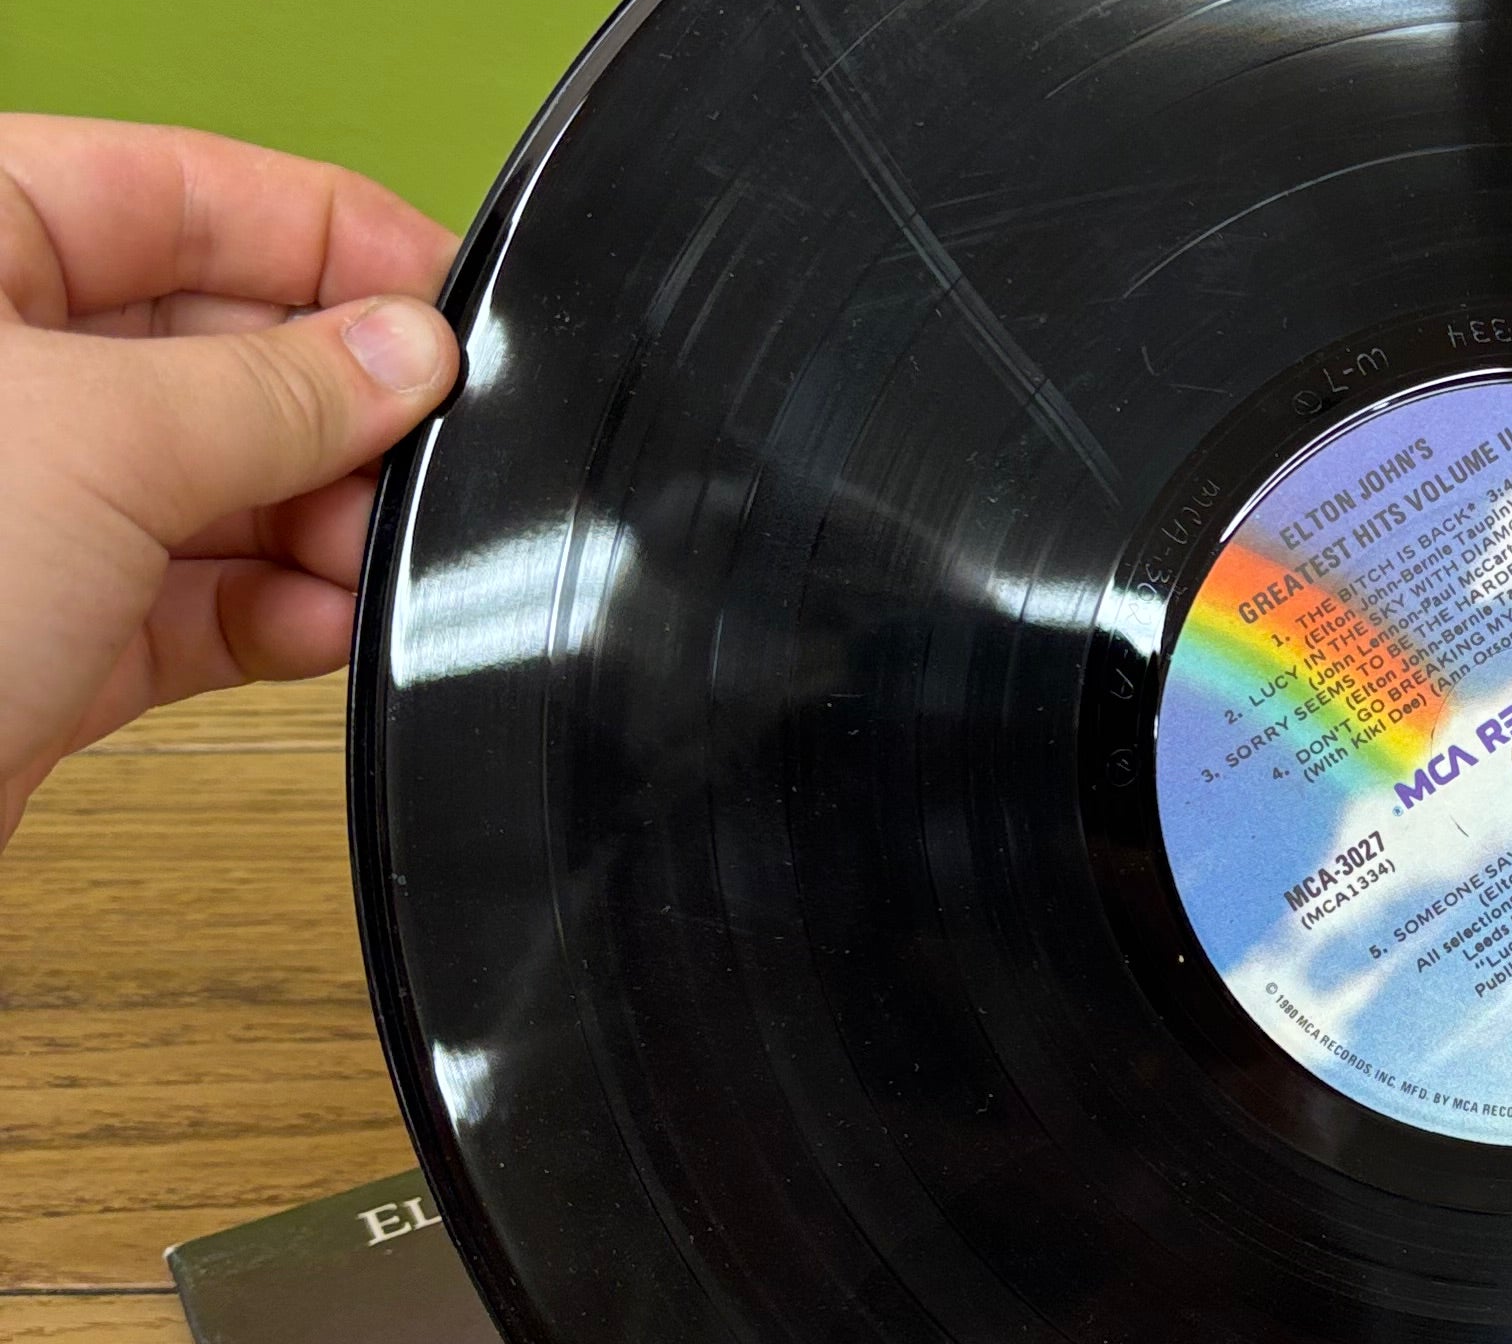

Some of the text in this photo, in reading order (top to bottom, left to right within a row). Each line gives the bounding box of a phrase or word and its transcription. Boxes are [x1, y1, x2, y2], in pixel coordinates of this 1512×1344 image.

[1239, 537, 1351, 624] GREATEST
[1352, 503, 1406, 548] HITS
[1403, 441, 1499, 511] VOLUME
[1280, 438, 1433, 550] ELTON JOHN'S
[1224, 710, 1243, 724] 2.
[1249, 665, 1298, 707] LUCY
[1304, 649, 1326, 670] IN
[1327, 622, 1368, 652] THE
[1369, 594, 1404, 626] SKY
[1409, 560, 1459, 597] WITH
[1271, 634, 1290, 647] 1.
[1295, 598, 1336, 629] THE
[1338, 559, 1394, 603] BITCH
[1397, 545, 1415, 563] IS
[1305, 610, 1355, 649] (Elton
[1361, 545, 1452, 611] John-Bernie
[1309, 655, 1355, 691] (John
[1357, 583, 1456, 657] Lennon-Paul
[1201, 769, 1220, 783] 3.
[1225, 716, 1288, 768] SORRY
[1294, 675, 1355, 721] SEEMS
[1356, 655, 1384, 676] TO
[1387, 635, 1413, 658] BE
[1414, 608, 1454, 638] THE
[1273, 767, 1289, 779] 4.
[1296, 718, 1351, 764] DON'T
[1357, 699, 1385, 722] GO
[1387, 632, 1485, 702] BREAKING
[1486, 608, 1512, 635] MY
[1346, 670, 1397, 710] (Elton
[1402, 606, 1493, 672] John-Bernie
[1304, 748, 1348, 783] (With
[1351, 719, 1386, 749] Kiki
[1388, 693, 1427, 724] Dee)
[1431, 664, 1470, 697] (Ann
[1394, 745, 1478, 809] MCA
[1284, 830, 1384, 911] MCA-3027
[1301, 859, 1395, 930] (MCA1334)
[1369, 945, 1388, 959] 5.
[1394, 873, 1485, 942] SOMEONE
[1417, 948, 1440, 973] All
[1462, 925, 1510, 961] Leeds
[1276, 995, 1298, 1019] 1980
[1296, 1015, 1320, 1040] MCA
[1375, 1070, 1395, 1088] INC.
[1433, 1092, 1450, 1105] BY
[1452, 1098, 1478, 1113] MCA
